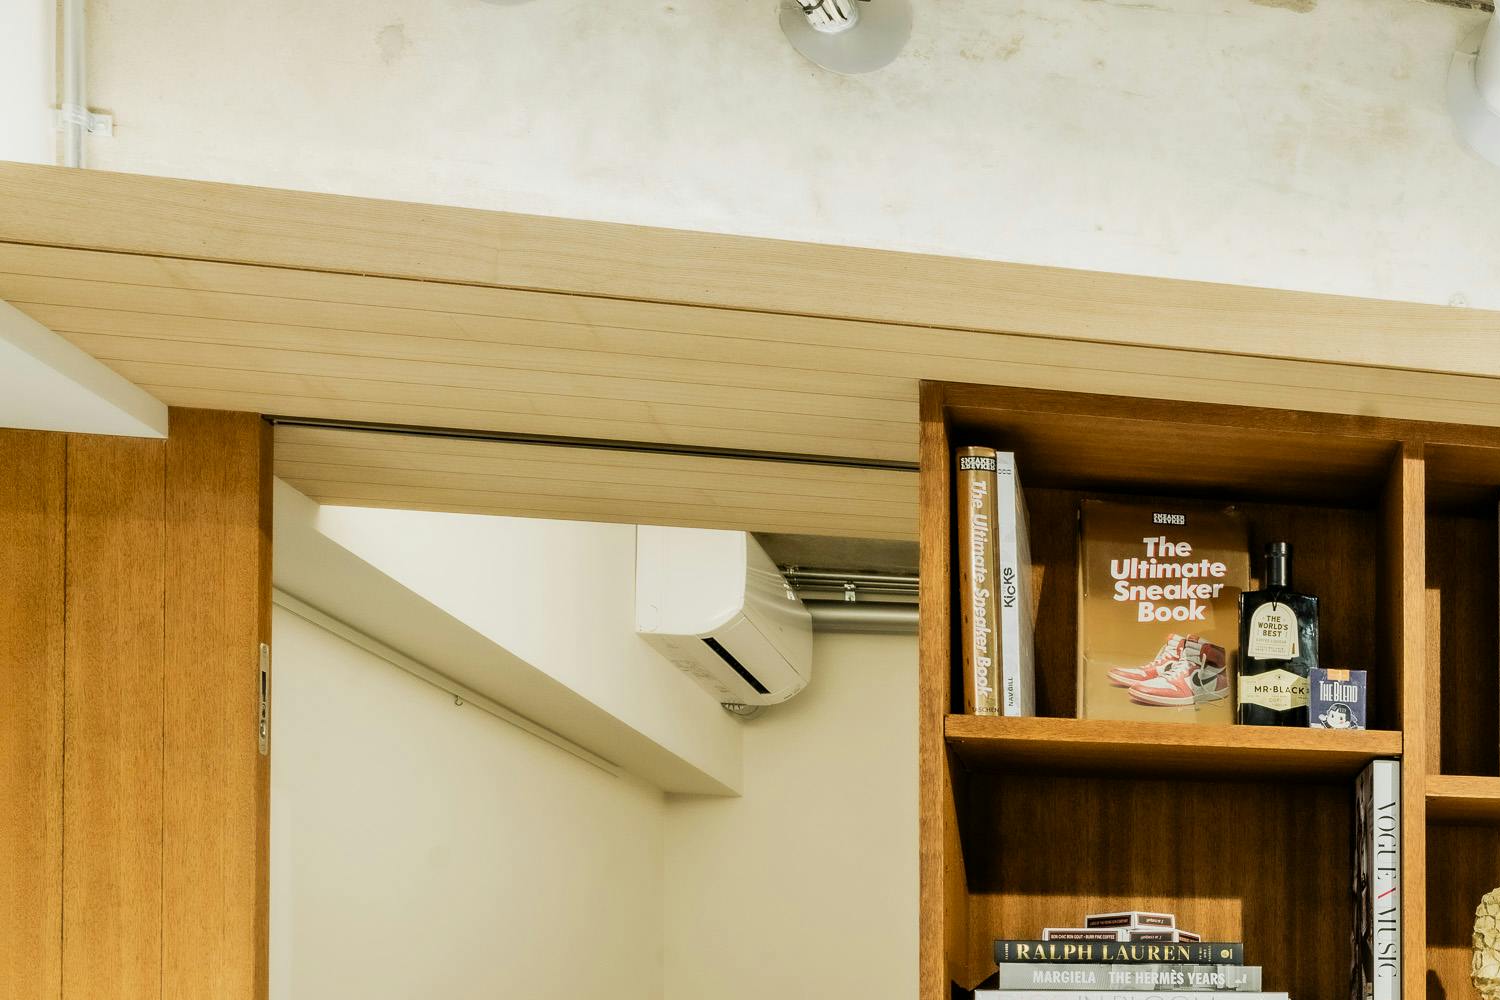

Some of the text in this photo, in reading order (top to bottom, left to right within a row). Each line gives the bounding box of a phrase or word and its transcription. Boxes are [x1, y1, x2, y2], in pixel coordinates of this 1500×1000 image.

[1143, 536, 1193, 557] The
[1110, 558, 1227, 580] Ultimate
[972, 481, 992, 698] The Ultimate Sneaker Book
[1113, 578, 1224, 601] Sneaker
[1138, 598, 1206, 622] Book
[1258, 622, 1289, 630] WORLD'S
[1377, 801, 1397, 978] VOGUE MUSIC
[1016, 943, 1093, 960] RALPH
[1102, 944, 1191, 961] LAUREN
[1033, 968, 1226, 986] MARGIELA THE HERMÈS YEARS
